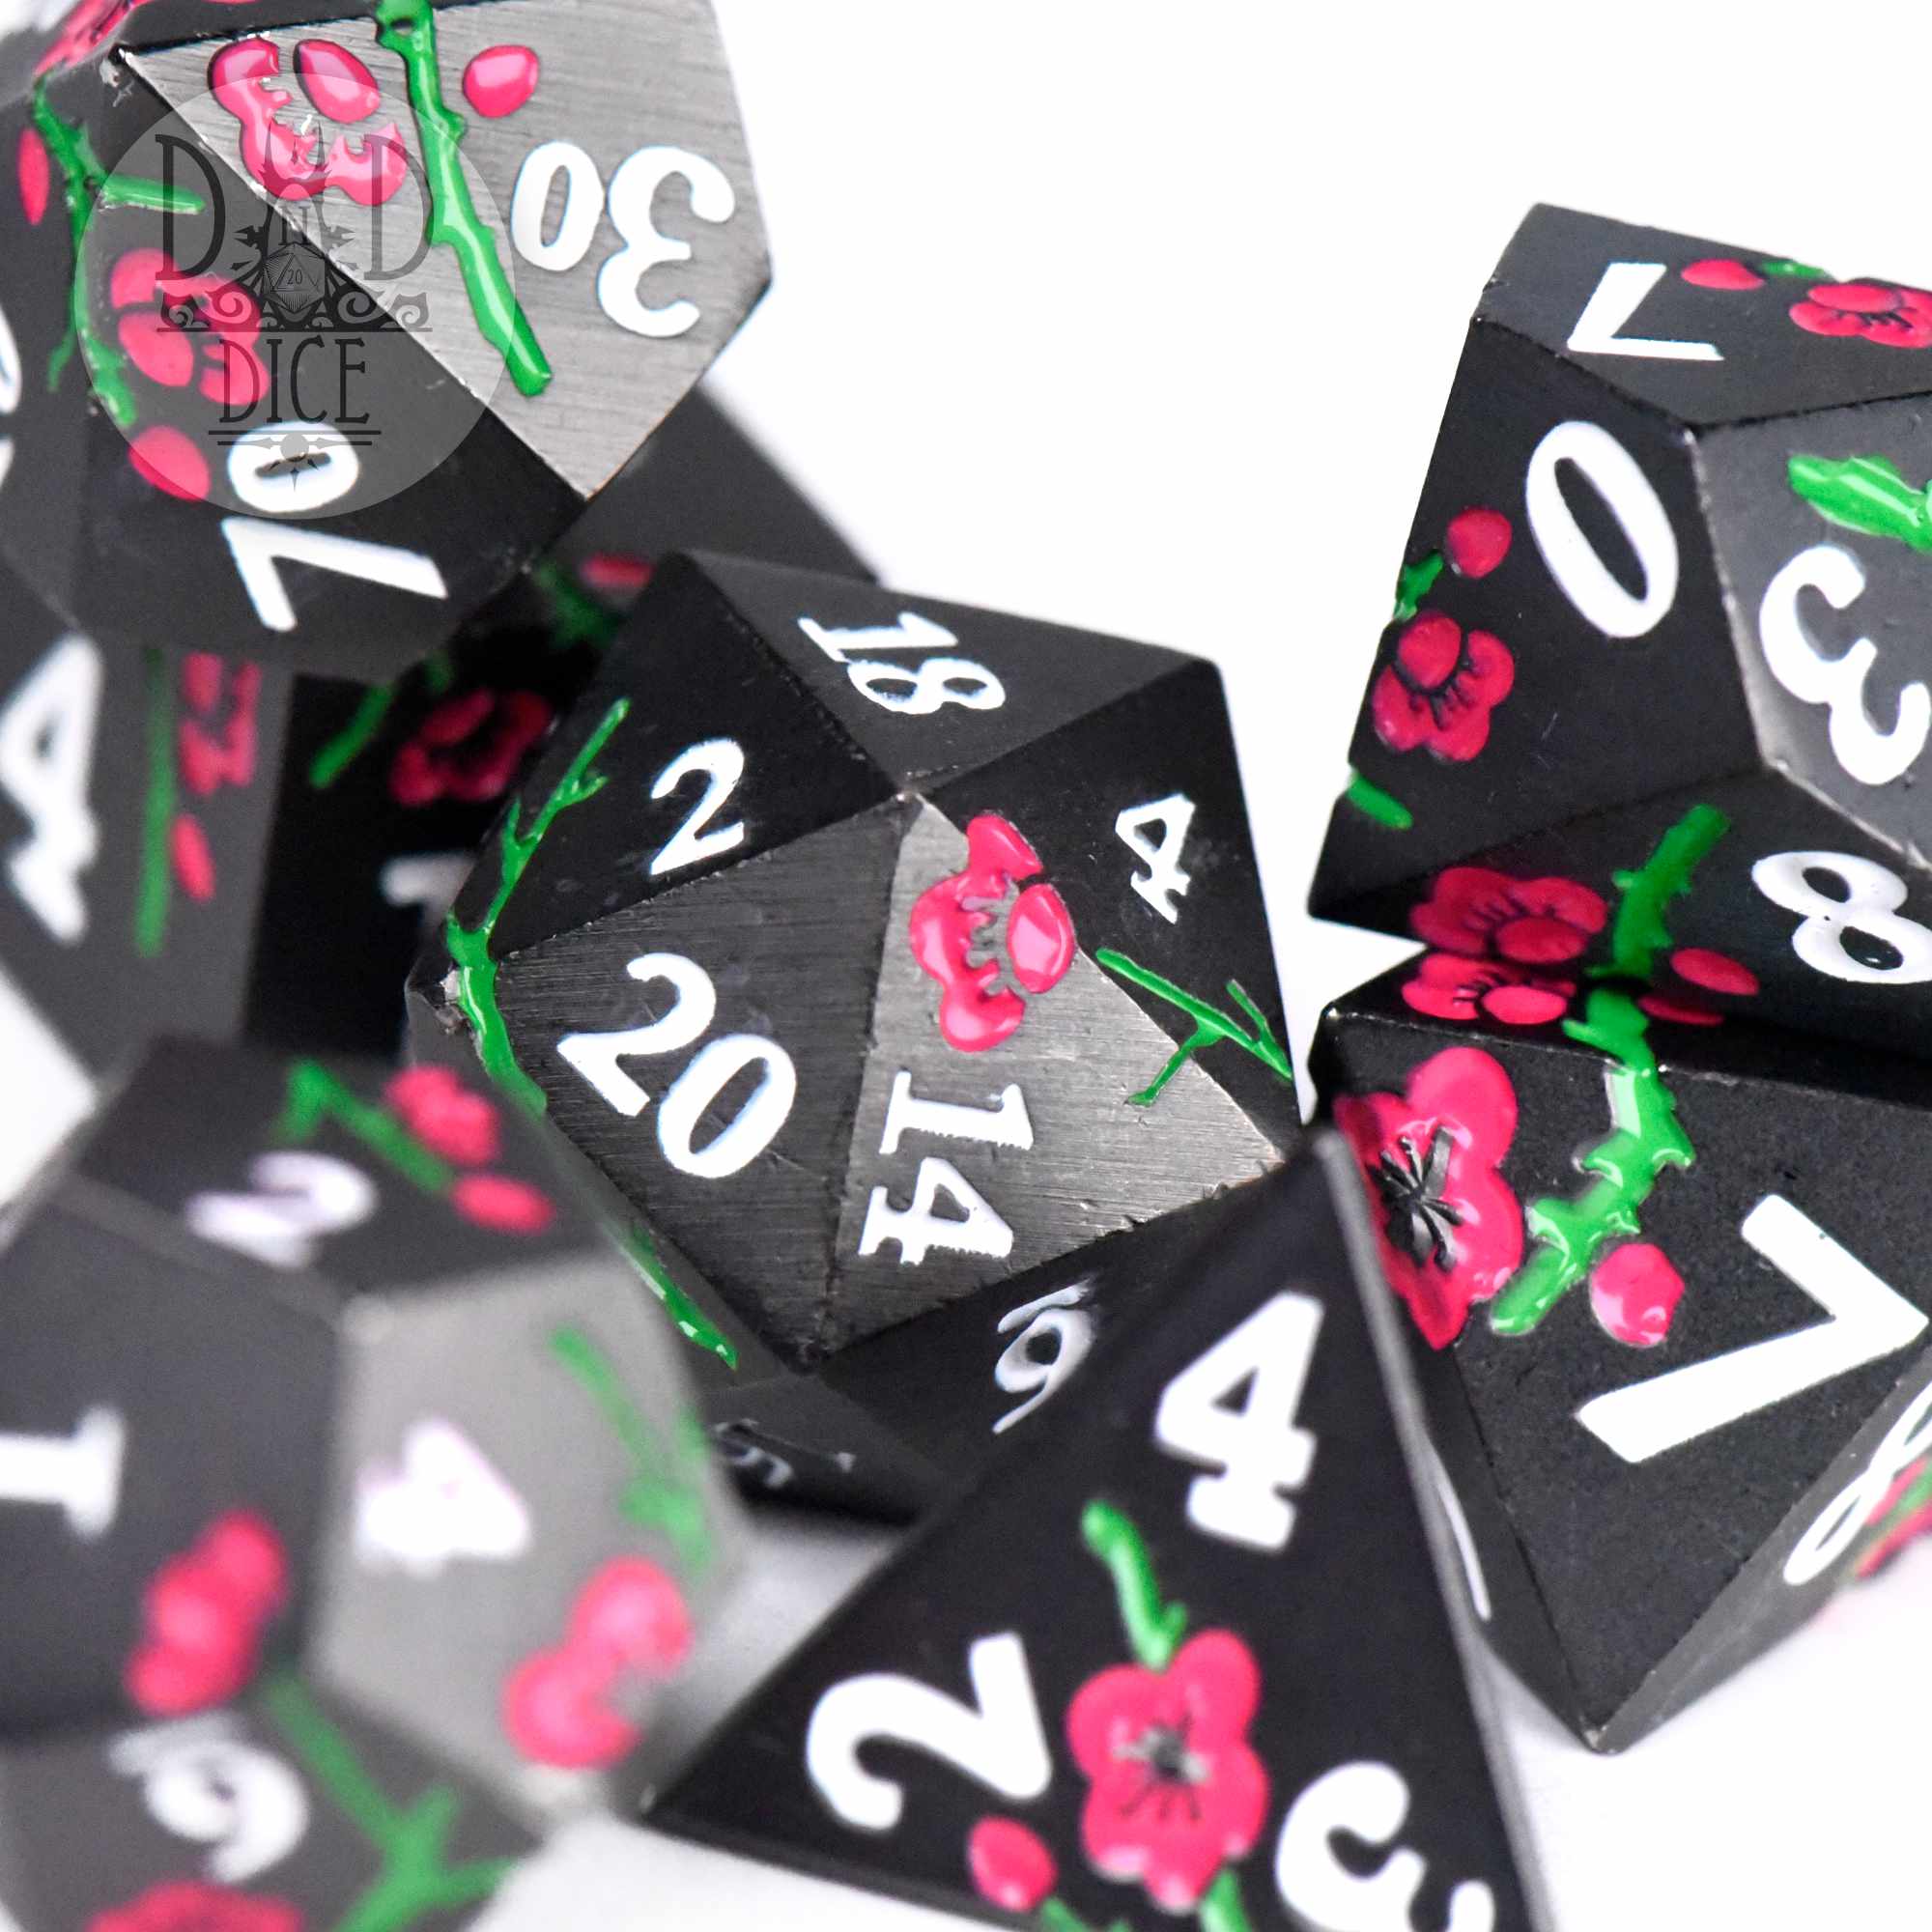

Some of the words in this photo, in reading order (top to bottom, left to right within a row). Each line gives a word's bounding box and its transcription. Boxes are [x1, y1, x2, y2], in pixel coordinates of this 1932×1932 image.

[512, 141, 735, 337] 30
[1566, 260, 1725, 362] 7
[1525, 420, 1679, 639] 0
[797, 611, 1007, 715] 18
[1759, 545, 1932, 785] 3
[0, 633, 101, 945] 4
[650, 738, 745, 876] 2
[1115, 793, 1196, 924] 4
[1750, 850, 1932, 984] 8
[556, 952, 797, 1179] 20
[861, 1069, 1034, 1268] 14
[1155, 1291, 1323, 1550] 4
[1575, 1194, 1930, 1463] 7
[806, 1632, 1053, 1832] 2
